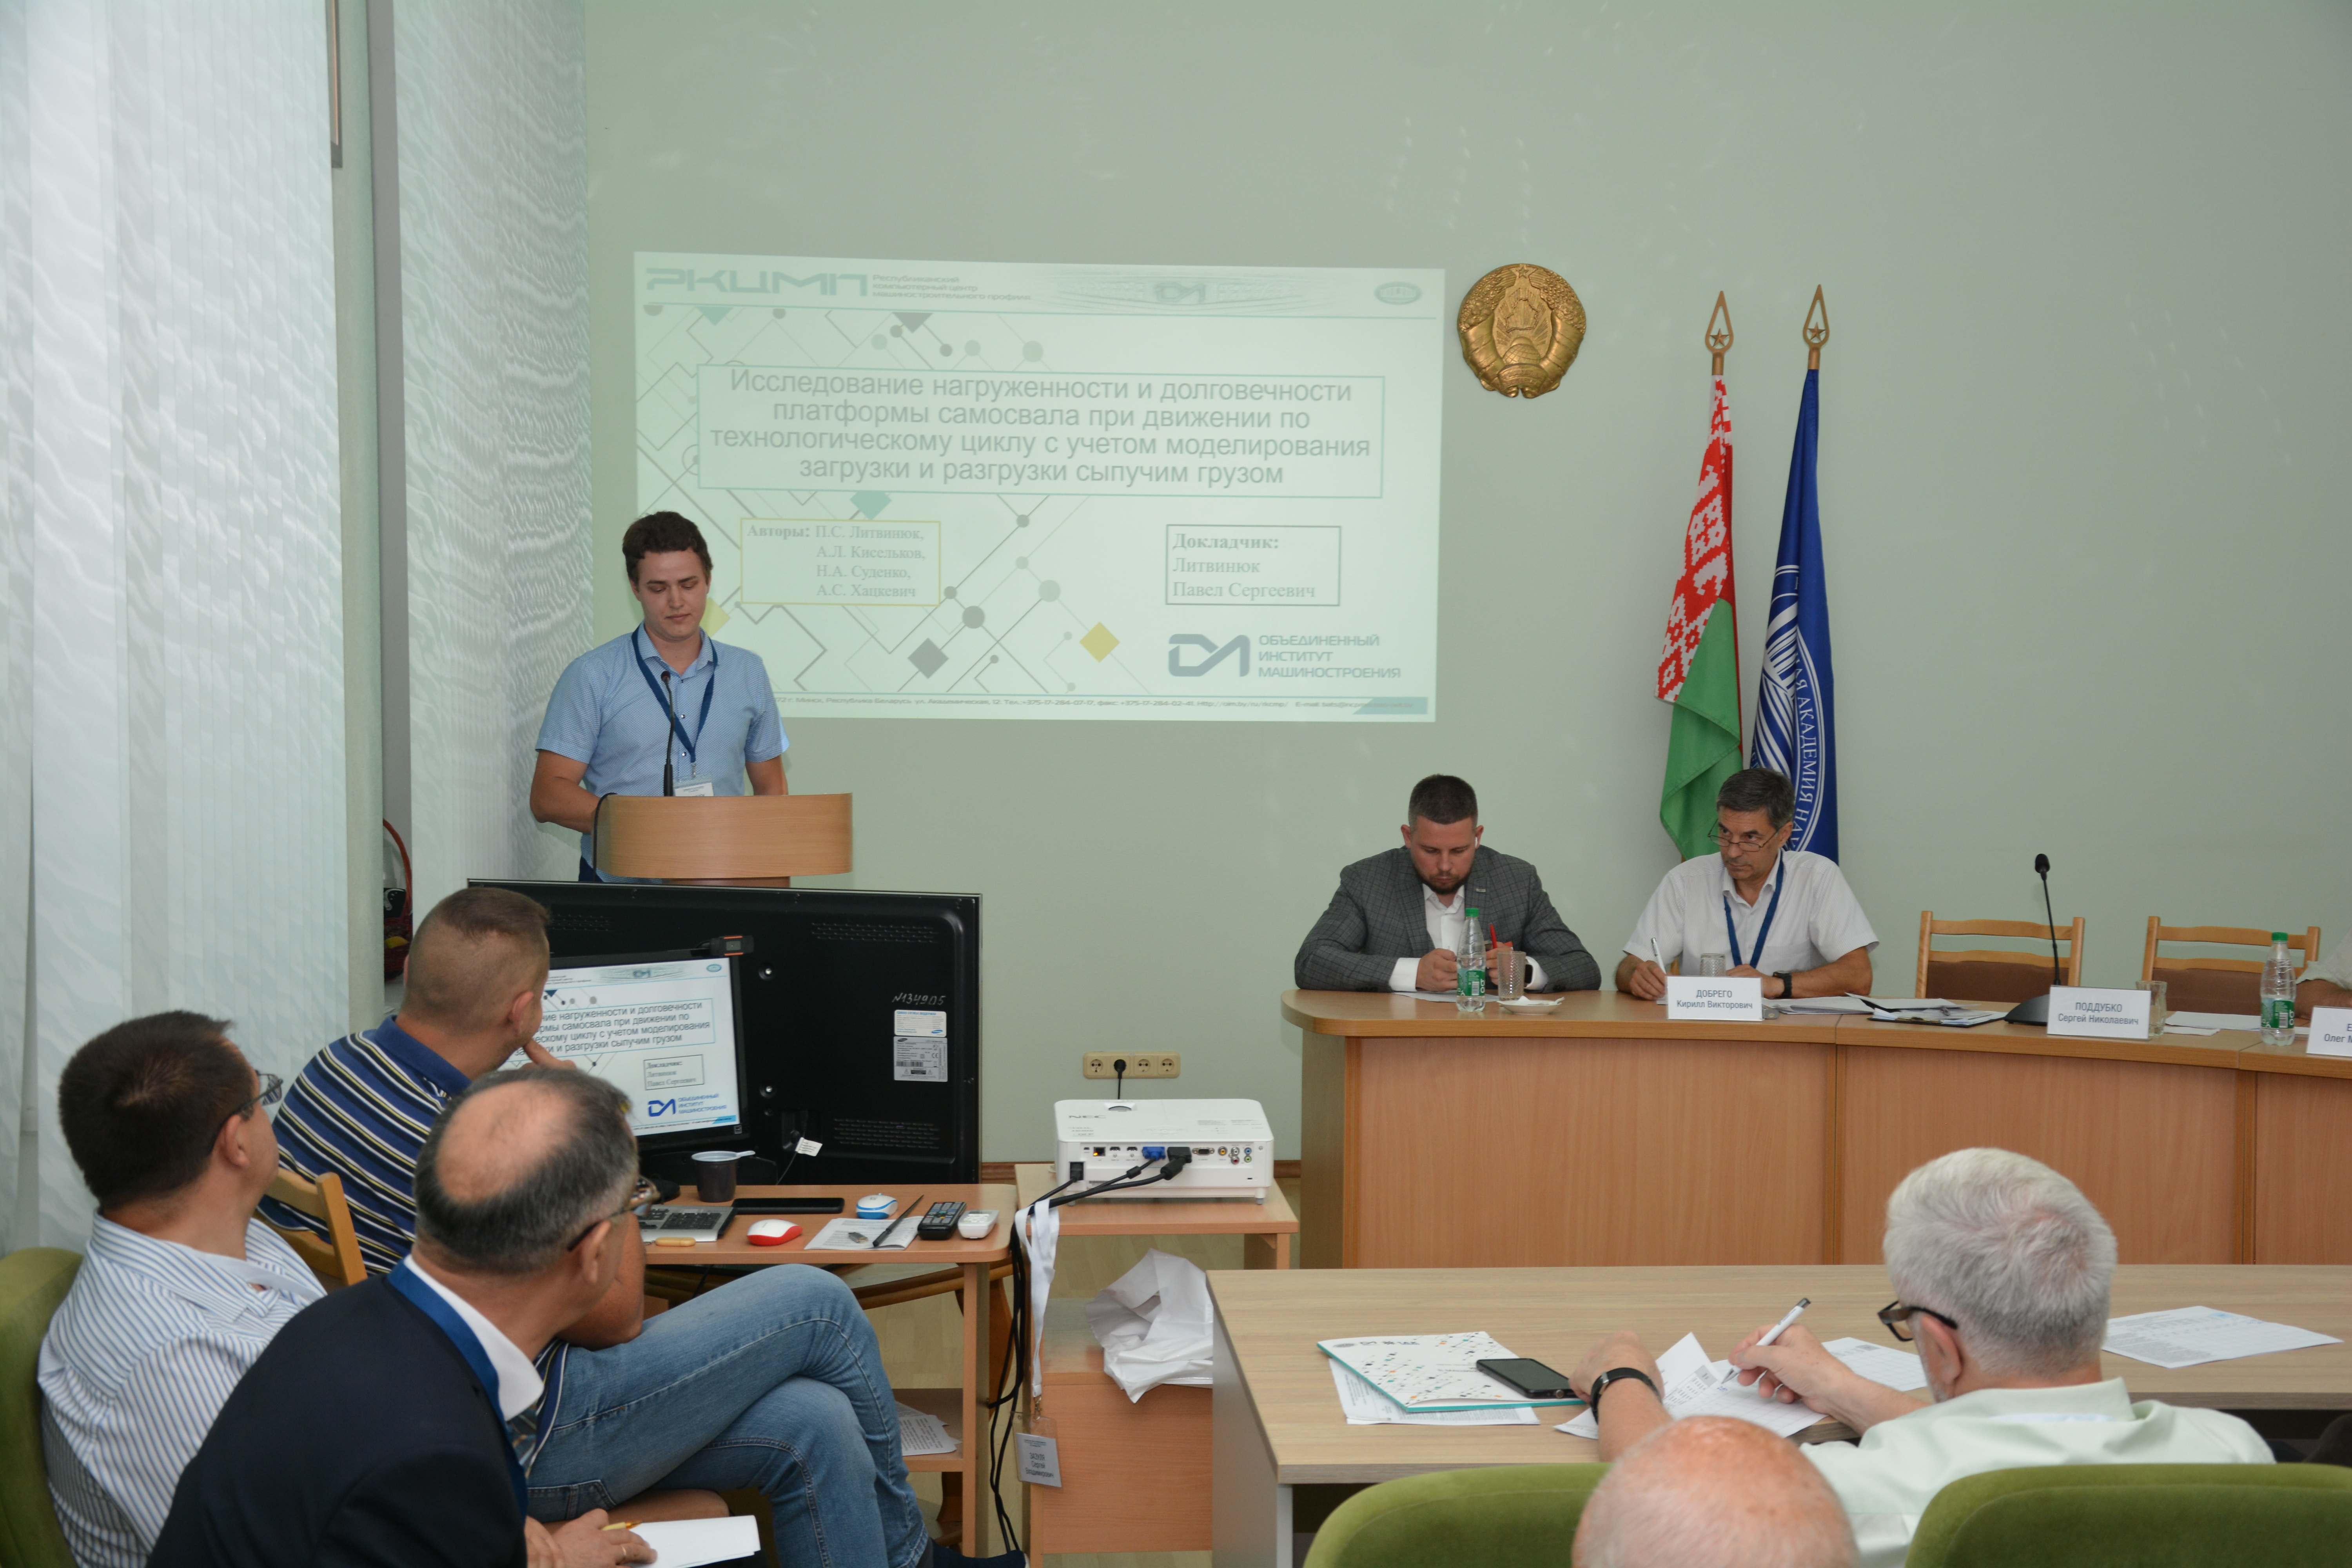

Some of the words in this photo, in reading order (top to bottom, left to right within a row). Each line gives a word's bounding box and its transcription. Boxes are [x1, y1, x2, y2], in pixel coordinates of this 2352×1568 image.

[873, 274, 959, 283] Республиканский
[873, 291, 985, 299] машиностроительного
[731, 368, 924, 397] Исследование
[933, 377, 1129, 402] нагруженности
[1138, 381, 1152, 399] и
[1160, 382, 1352, 403] долговечности
[773, 399, 929, 427] платформы
[937, 406, 1080, 426] самосвала
[1089, 409, 1134, 431] при
[1142, 410, 1272, 431] движении
[1280, 411, 1310, 429] по
[710, 428, 952, 456] технологическому
[960, 434, 1036, 458] циклу
[1044, 436, 1058, 453] с
[1066, 436, 1157, 459] учетом
[1167, 437, 1370, 461] моделирования
[800, 457, 910, 483] загрузки
[919, 461, 934, 479] и
[944, 462, 1067, 486] разгрузки
[1076, 464, 1189, 488] сыпучим
[1197, 466, 1283, 488] грузом
[747, 524, 811, 539] Авторы:
[815, 525, 846, 538] П.С.
[851, 526, 924, 542] Литвинюк,
[1172, 533, 1279, 552] Докладчик:
[816, 545, 846, 559] А.Л.
[850, 546, 926, 561] Кисельков,
[816, 564, 847, 578] Н.А.
[851, 565, 911, 581] Суденко,
[1172, 557, 1261, 573] Литвинюк
[816, 583, 847, 597] А.С.
[850, 584, 916, 600] Хацкевич
[1172, 582, 1223, 597] Павел
[1228, 582, 1316, 601] Сергеевич
[1258, 633, 1380, 646] ОБЪЕДИНЕННЫЙ
[1258, 651, 1333, 662] ИНСТИТУТ
[1258, 667, 1401, 679] МАШИНОСТРОЕНИЯ
[1797, 697, 1818, 804] АКАДЕМИЯ
[1696, 989, 1733, 999] ДОБРЕГО
[559, 1008, 628, 1022] нагруженности
[637, 1001, 703, 1015] долговечности
[1677, 1000, 1705, 1009] Кирилл
[1708, 1000, 1753, 1009] Викторович
[2075, 1002, 2123, 1013] ПОДДУБКО
[562, 1020, 611, 1032] самосвала
[614, 1018, 631, 1028] при
[632, 1014, 677, 1026] движении
[2058, 1013, 2087, 1025] Сергей
[2089, 1015, 2139, 1025] Николаевич
[571, 1030, 597, 1042] циклу
[607, 1027, 639, 1040] учетом
[641, 1021, 710, 1036] моделирования
[2324, 1034, 2346, 1043] Олег
[564, 1041, 609, 1054] разгрузки
[610, 1037, 651, 1050] сыпучим
[652, 1034, 683, 1046] грузом
